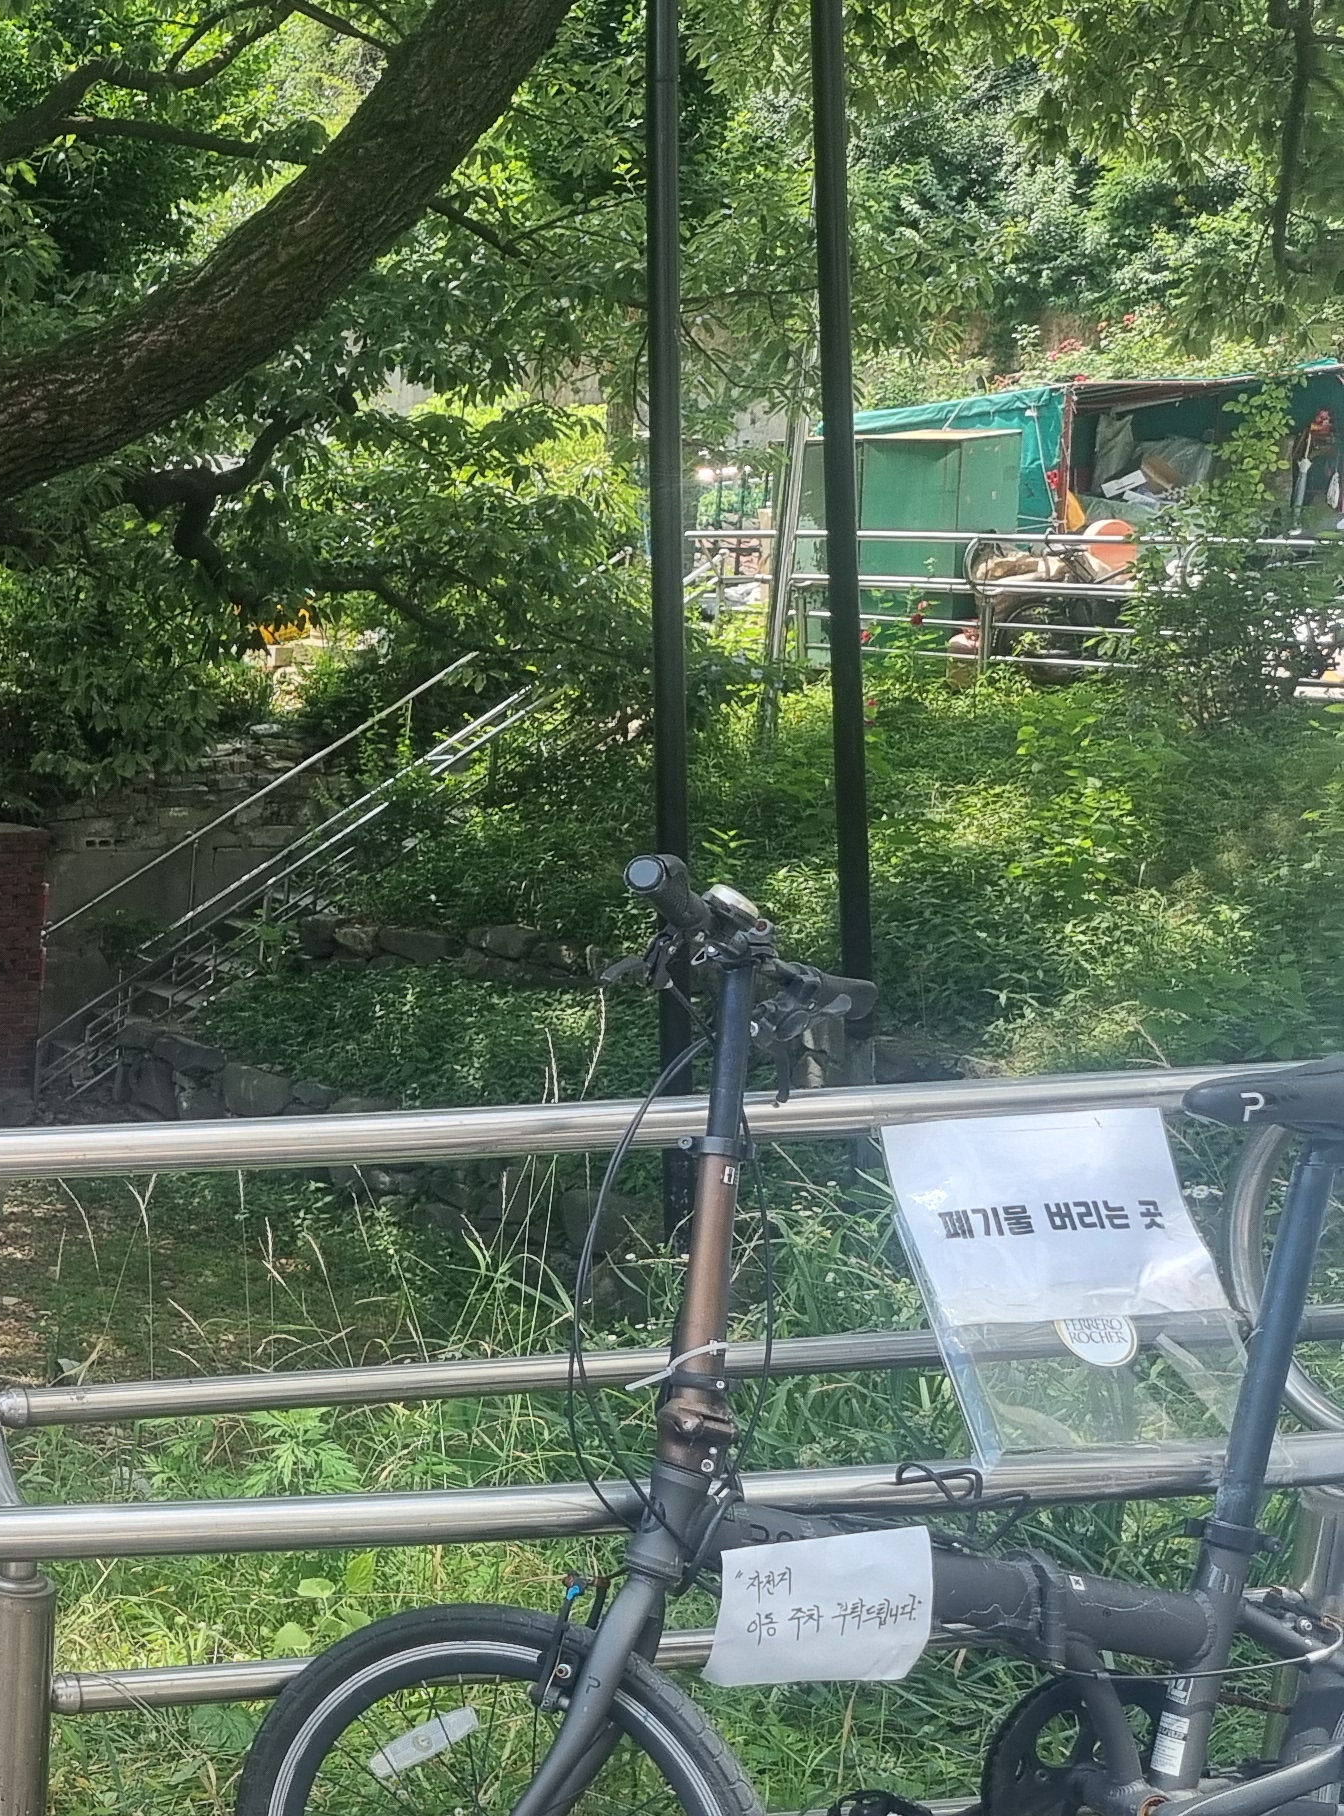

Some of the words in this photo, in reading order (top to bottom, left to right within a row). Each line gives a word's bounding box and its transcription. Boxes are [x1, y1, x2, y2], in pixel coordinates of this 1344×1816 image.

[938, 1204, 1035, 1239] 폐기물
[1044, 1200, 1131, 1231] 버리는
[1137, 1200, 1165, 1230] 곳
[1063, 1318, 1122, 1331] FERRERO
[1069, 1331, 1128, 1344] ROCHER
[746, 1612, 779, 1645] 이동
[787, 1604, 824, 1641] 주차
